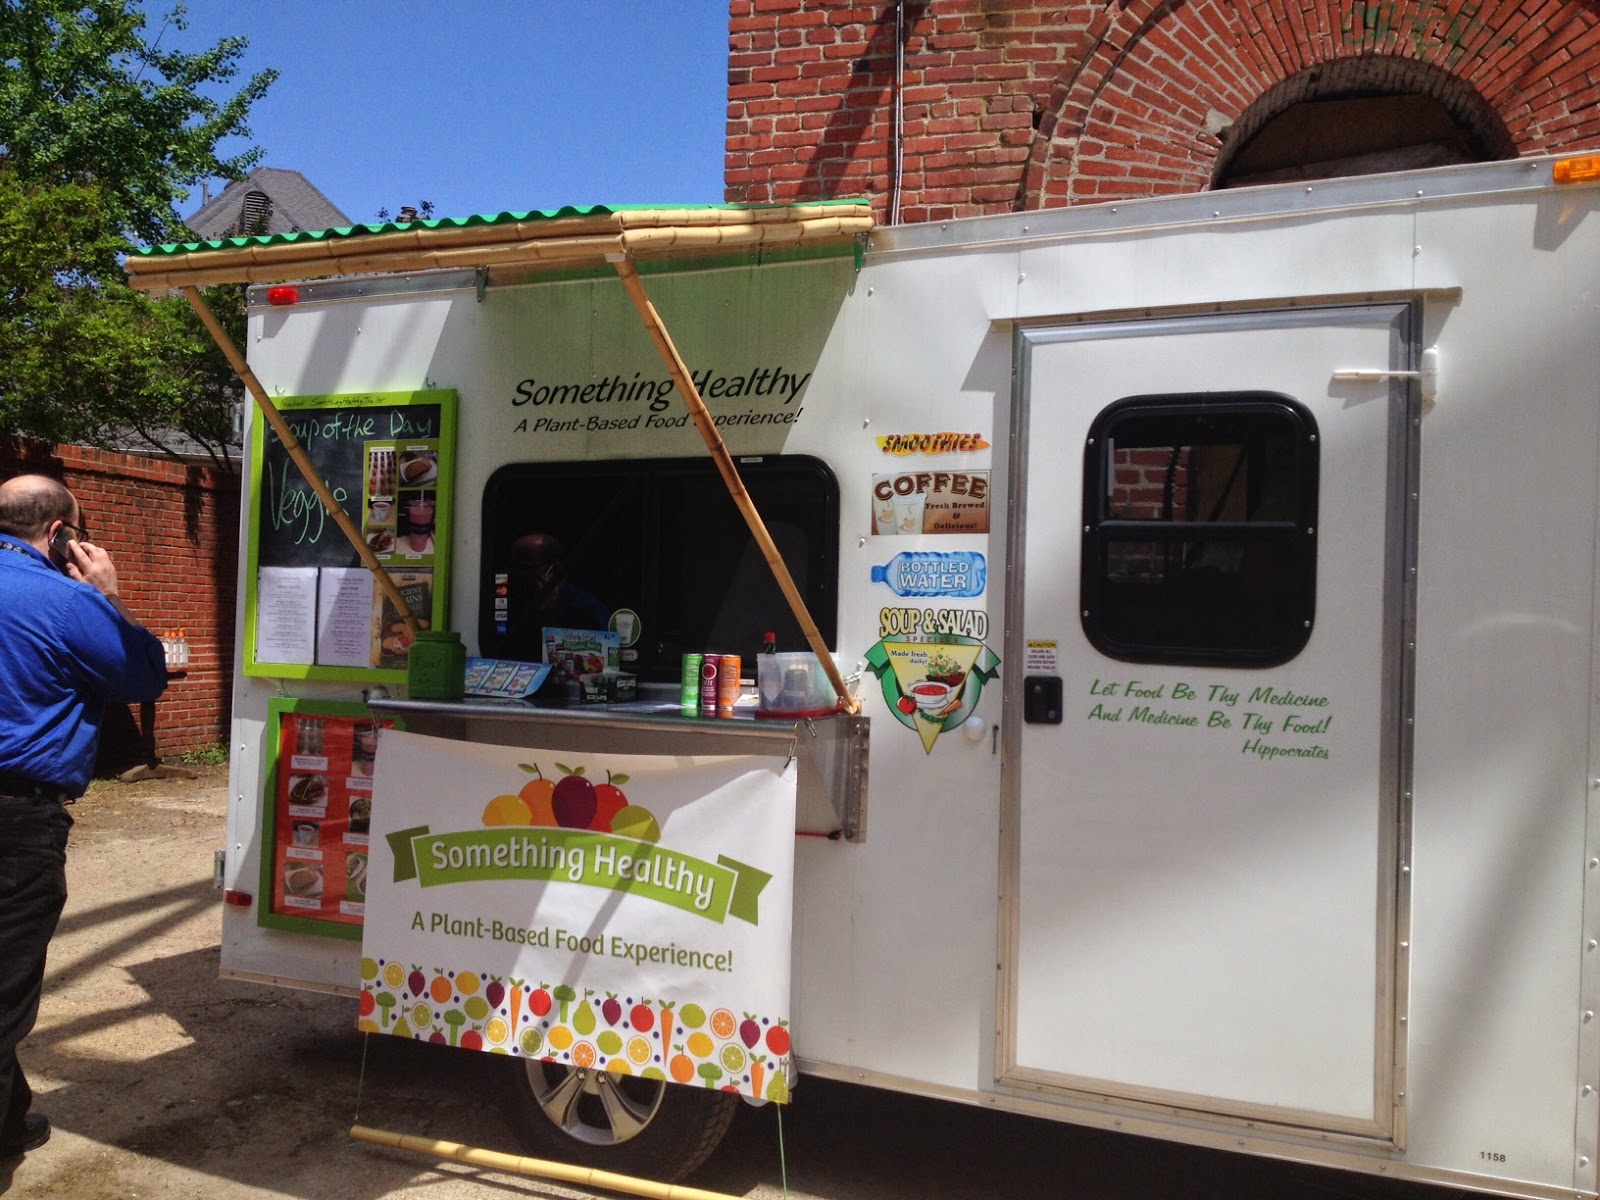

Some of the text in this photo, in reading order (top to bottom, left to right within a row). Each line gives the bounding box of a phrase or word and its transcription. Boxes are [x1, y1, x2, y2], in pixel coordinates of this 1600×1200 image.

[511, 366, 812, 411] Something Healthy
[323, 415, 348, 440] of
[342, 416, 376, 439] the
[390, 409, 432, 439] Day
[513, 407, 804, 433] A Plant-Based Food perience!
[882, 432, 981, 453] SMOOTHIES
[874, 472, 988, 501] COFFEE
[925, 501, 985, 511] Fresh Brewed
[952, 512, 961, 520] &
[899, 560, 970, 574] BOTTLED
[898, 573, 968, 589] WATER
[879, 606, 989, 641] SOUP & SALAD
[909, 657, 928, 666] daily!
[910, 650, 928, 658] fresh
[1089, 679, 1330, 707] Let Food Be Thy Medicine
[1088, 703, 1333, 735] And Medicine Be Thy Food!
[1242, 738, 1330, 761] Hippocrates
[430, 837, 716, 912] Something Healthy
[411, 910, 734, 973] A Plant-Based Food Experience!
[1480, 1151, 1506, 1163] 1158
